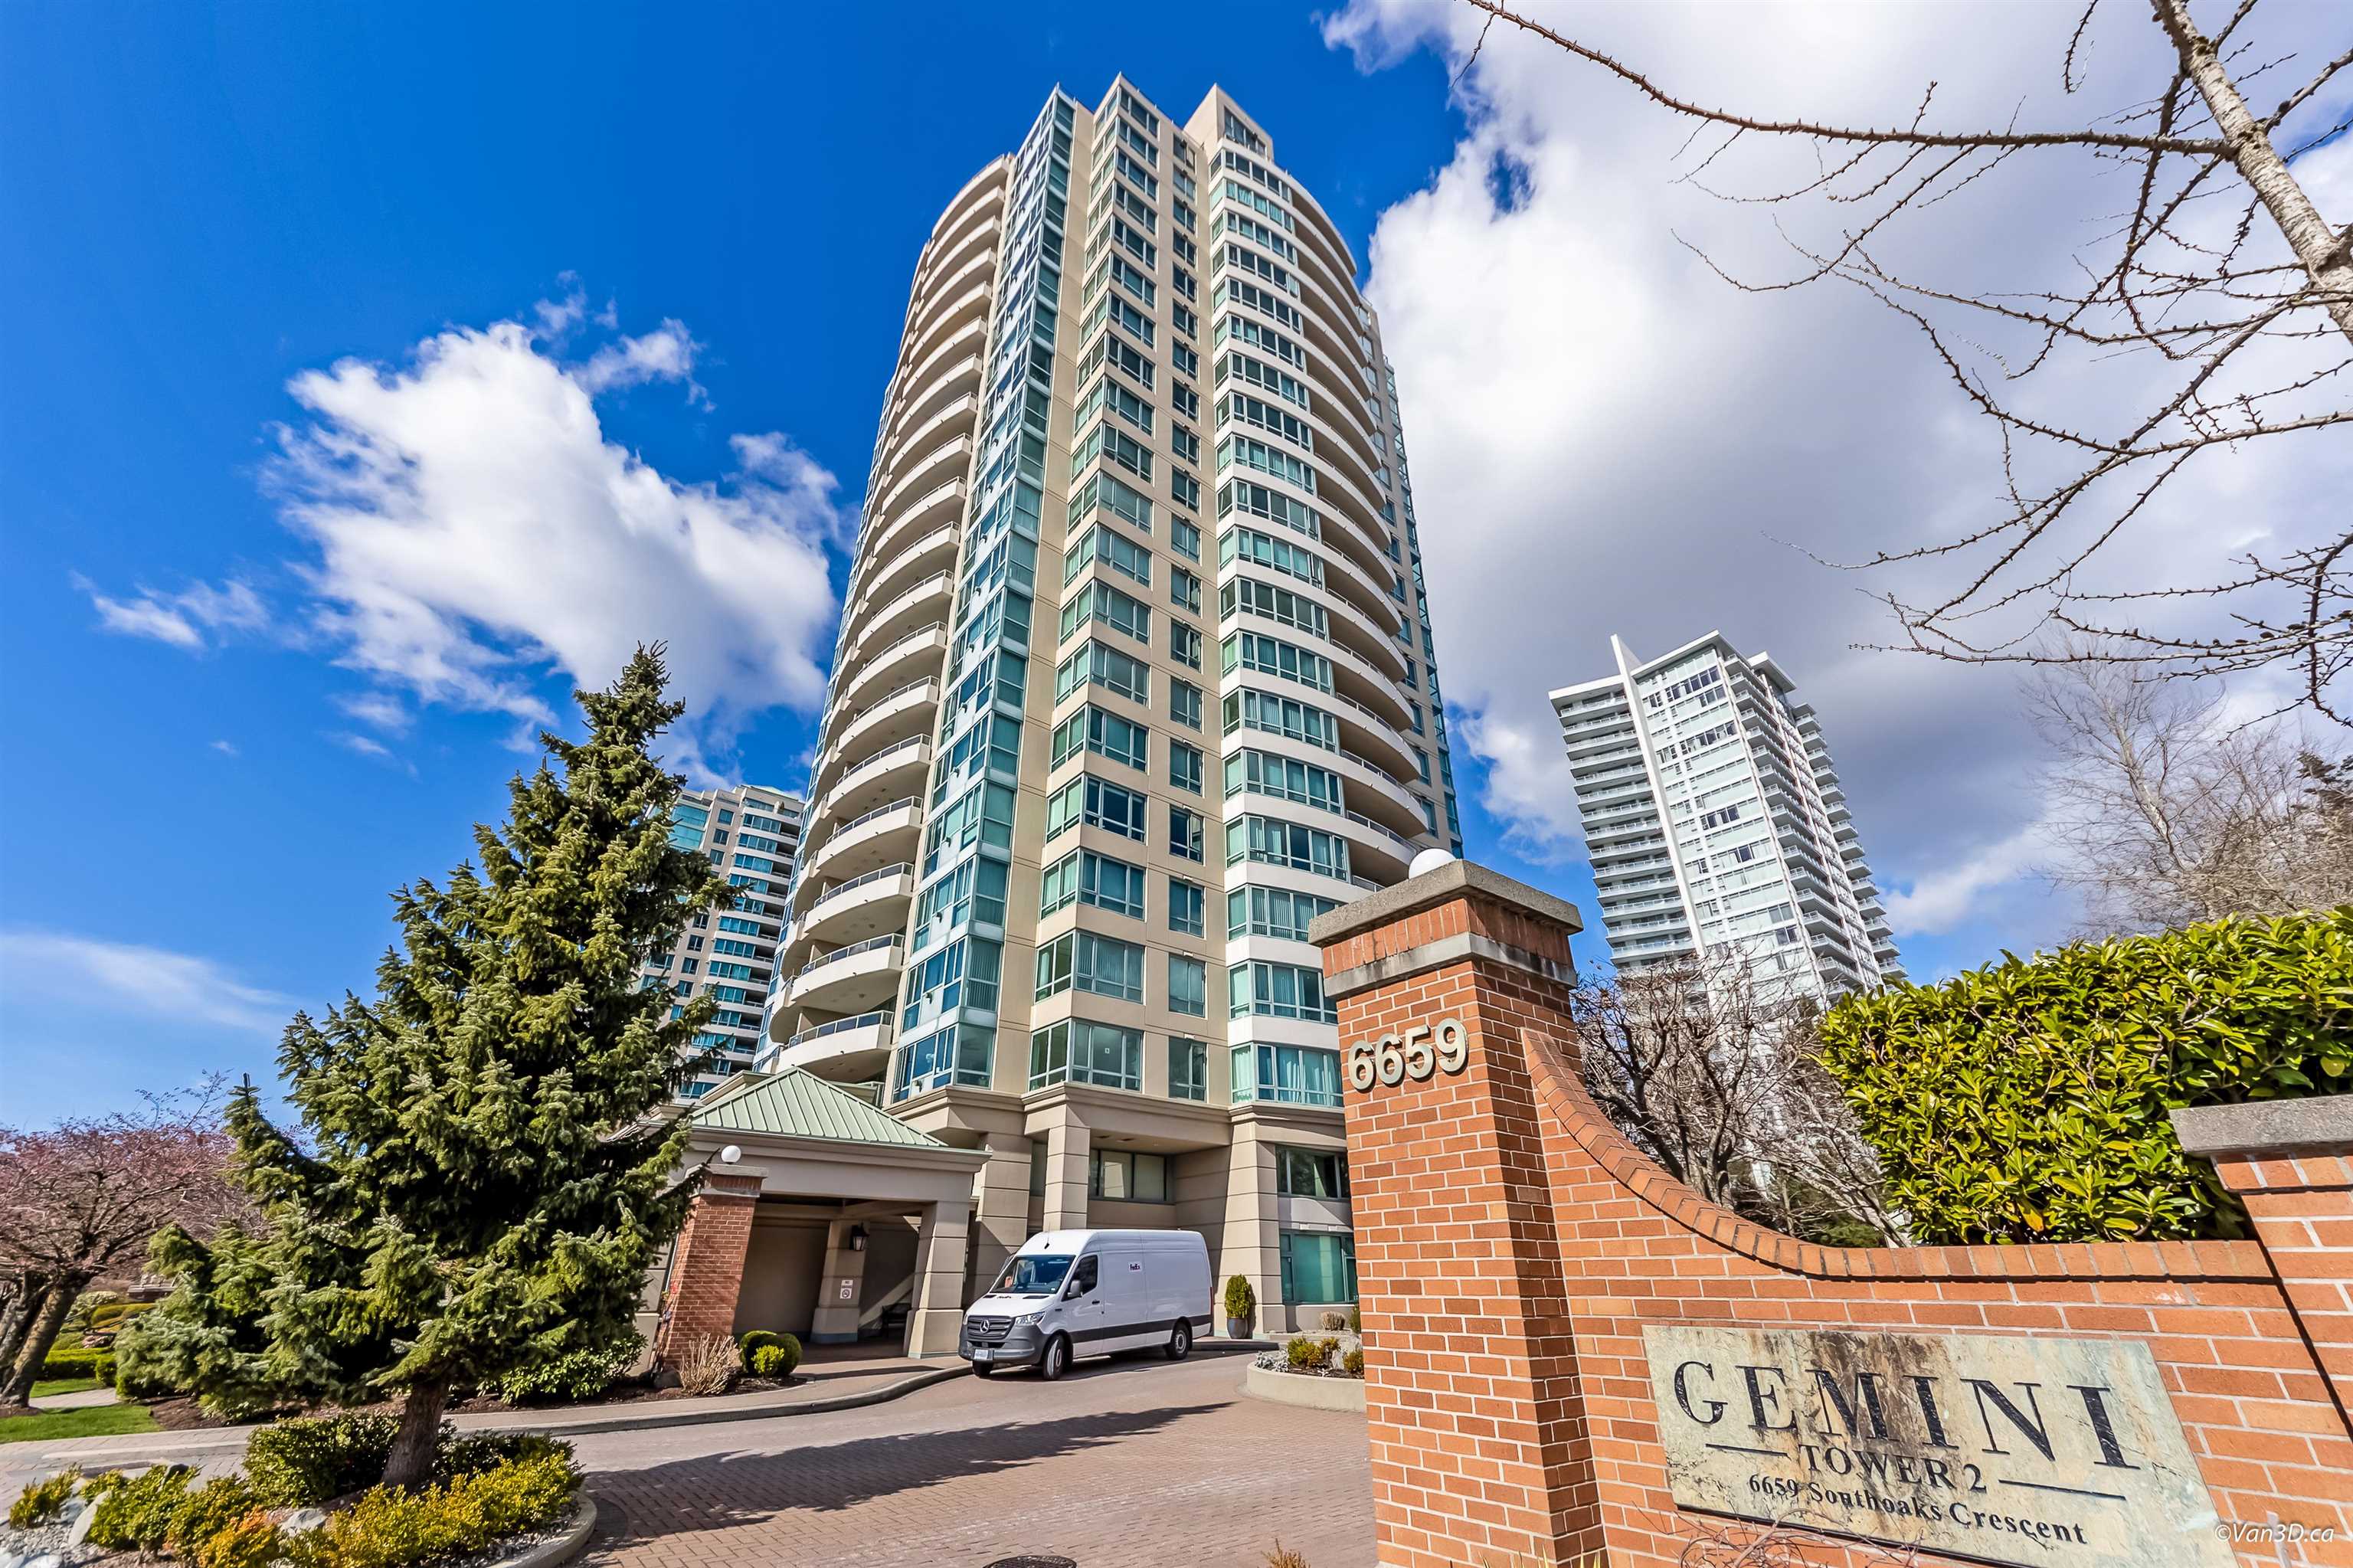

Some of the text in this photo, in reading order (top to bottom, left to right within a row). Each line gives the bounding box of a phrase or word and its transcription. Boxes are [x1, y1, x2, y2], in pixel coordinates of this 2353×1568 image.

[1348, 1017, 1469, 1092] 6659
[1674, 1360, 2141, 1470] GEMINI
[1798, 1444, 1988, 1494] TOWER 2
[1748, 1474, 2090, 1545] 6659 Southoaks Crescent
